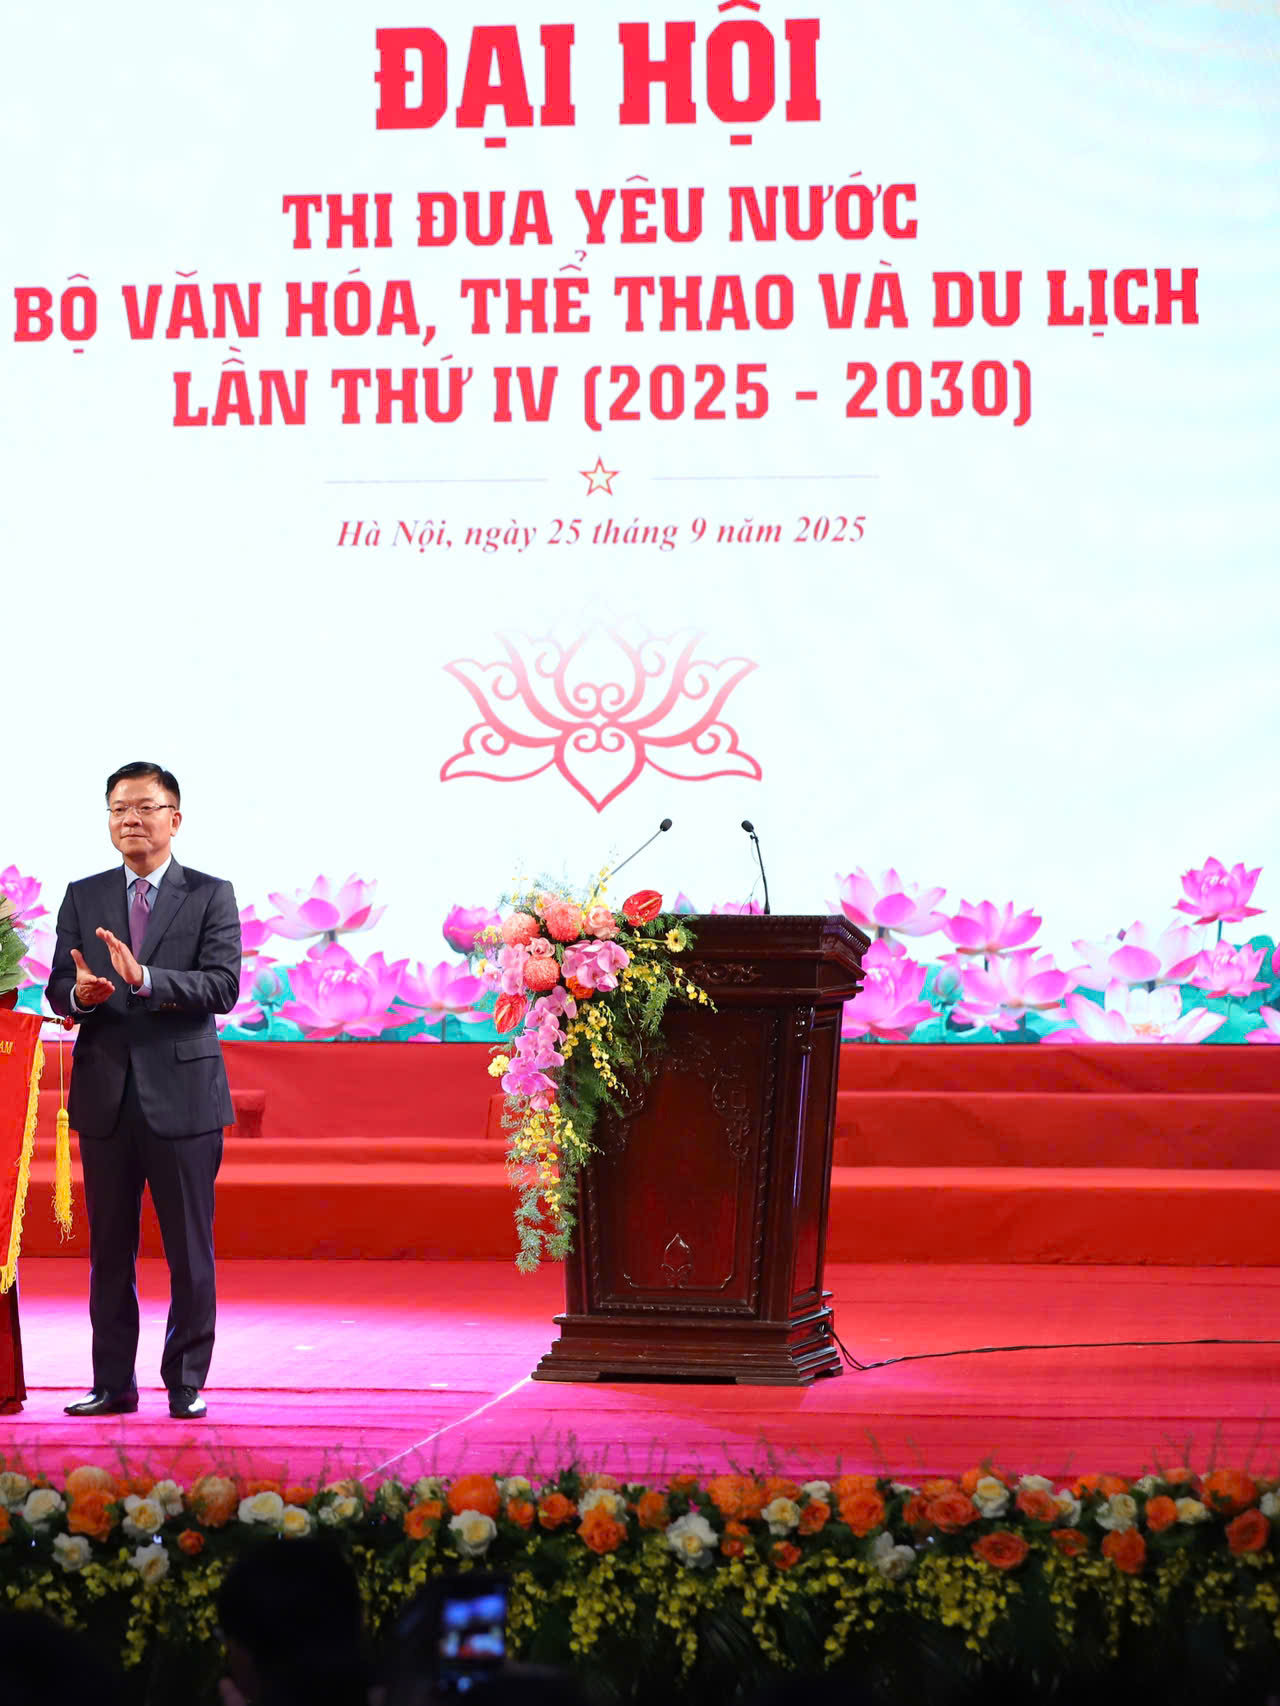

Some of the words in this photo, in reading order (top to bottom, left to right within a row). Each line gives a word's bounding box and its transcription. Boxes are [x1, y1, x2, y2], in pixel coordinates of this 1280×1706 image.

[373, 24, 577, 149] ĐẠI
[618, 0, 822, 147] HỘI
[281, 192, 393, 249] THI
[416, 189, 553, 248] ĐUA
[575, 175, 705, 245] YÊU
[728, 170, 919, 243] NƯỚC
[13, 272, 98, 354] BỘ
[121, 270, 262, 341] VĂN
[285, 267, 437, 347] HÓA,
[459, 250, 592, 335] THỂ
[614, 273, 795, 333] THAO
[817, 260, 909, 329] VÀ
[931, 270, 1023, 329] DU
[1047, 267, 1200, 337] LỊCH
[173, 345, 309, 428] LẦN
[331, 354, 473, 425] THỨ
[493, 365, 559, 423] IV
[583, 363, 769, 433] (2025
[795, 391, 818, 401] -
[845, 359, 1032, 427] 2030)
[337, 519, 381, 547] Hà
[392, 517, 454, 553] Nội,
[465, 518, 536, 553] ngày
[549, 519, 582, 545] 25
[592, 518, 678, 550] tháng
[691, 519, 707, 540] 9
[717, 516, 782, 543] năm
[796, 516, 866, 543] 2025
